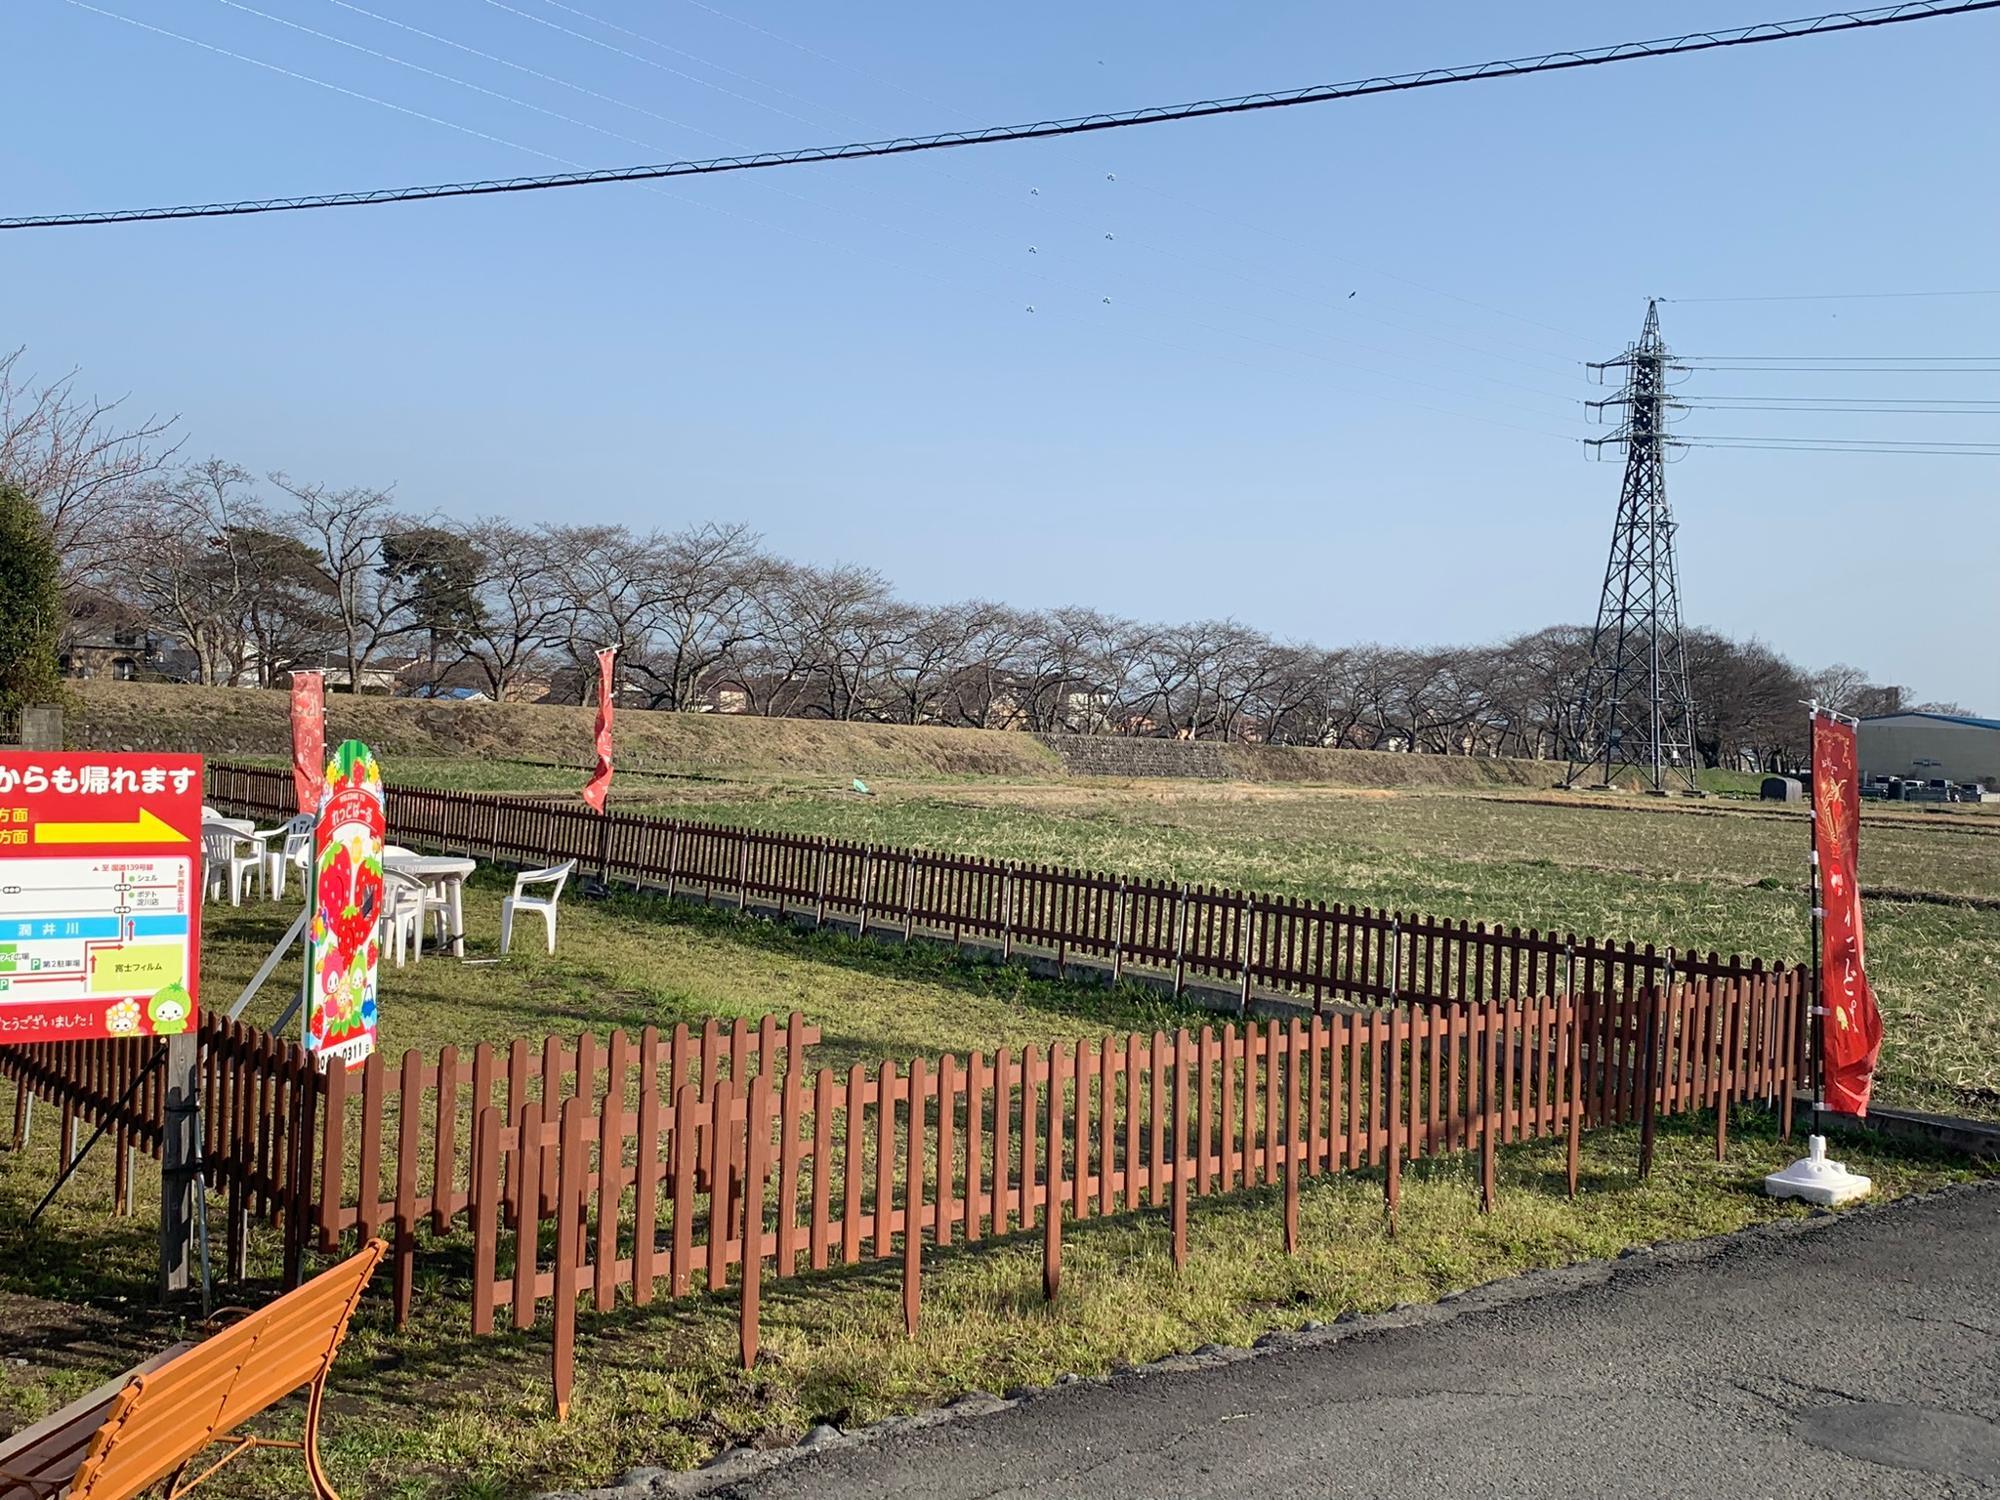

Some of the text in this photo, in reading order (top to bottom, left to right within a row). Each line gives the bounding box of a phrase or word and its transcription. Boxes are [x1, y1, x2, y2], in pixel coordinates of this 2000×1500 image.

[0, 765, 196, 795] からも帰れます
[0, 808, 28, 823] 方面
[0, 829, 28, 844] 方面
[43, 960, 81, 968] 第2駐車場
[0, 1013, 94, 1031] とうございました!
